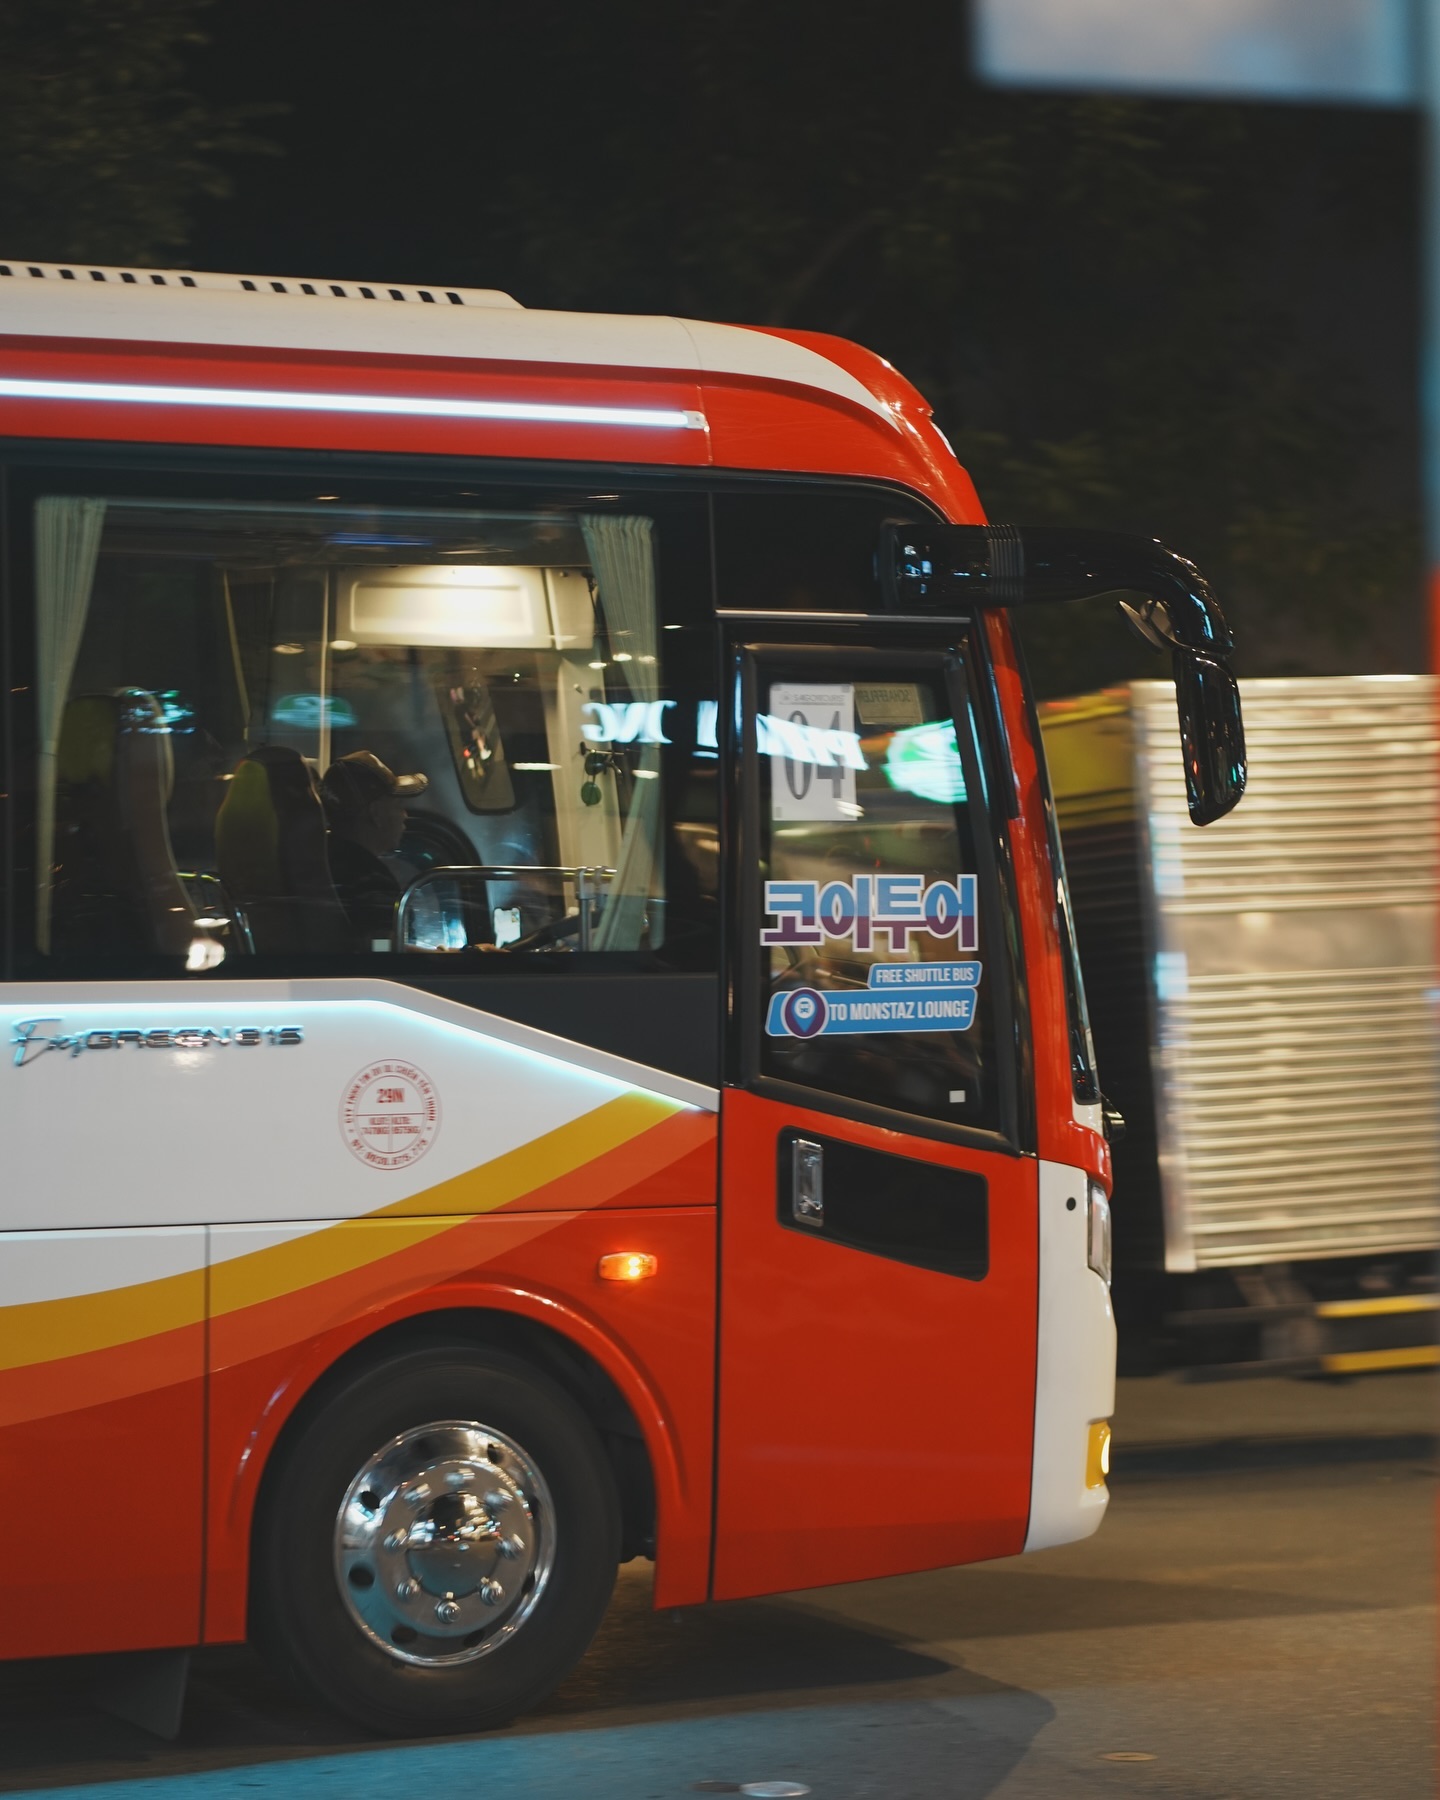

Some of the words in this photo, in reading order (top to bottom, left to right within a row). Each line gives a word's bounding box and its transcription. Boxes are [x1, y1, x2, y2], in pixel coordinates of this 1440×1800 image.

[784, 710, 845, 800] 04
[760, 874, 979, 952] 코이투어
[876, 969, 903, 983] FREE
[904, 968, 951, 982] SHUTTLE
[953, 967, 974, 981] BUS
[829, 1003, 846, 1021] TO
[849, 1002, 914, 1020] MONSTAZ
[917, 1000, 970, 1018] LOUNGE
